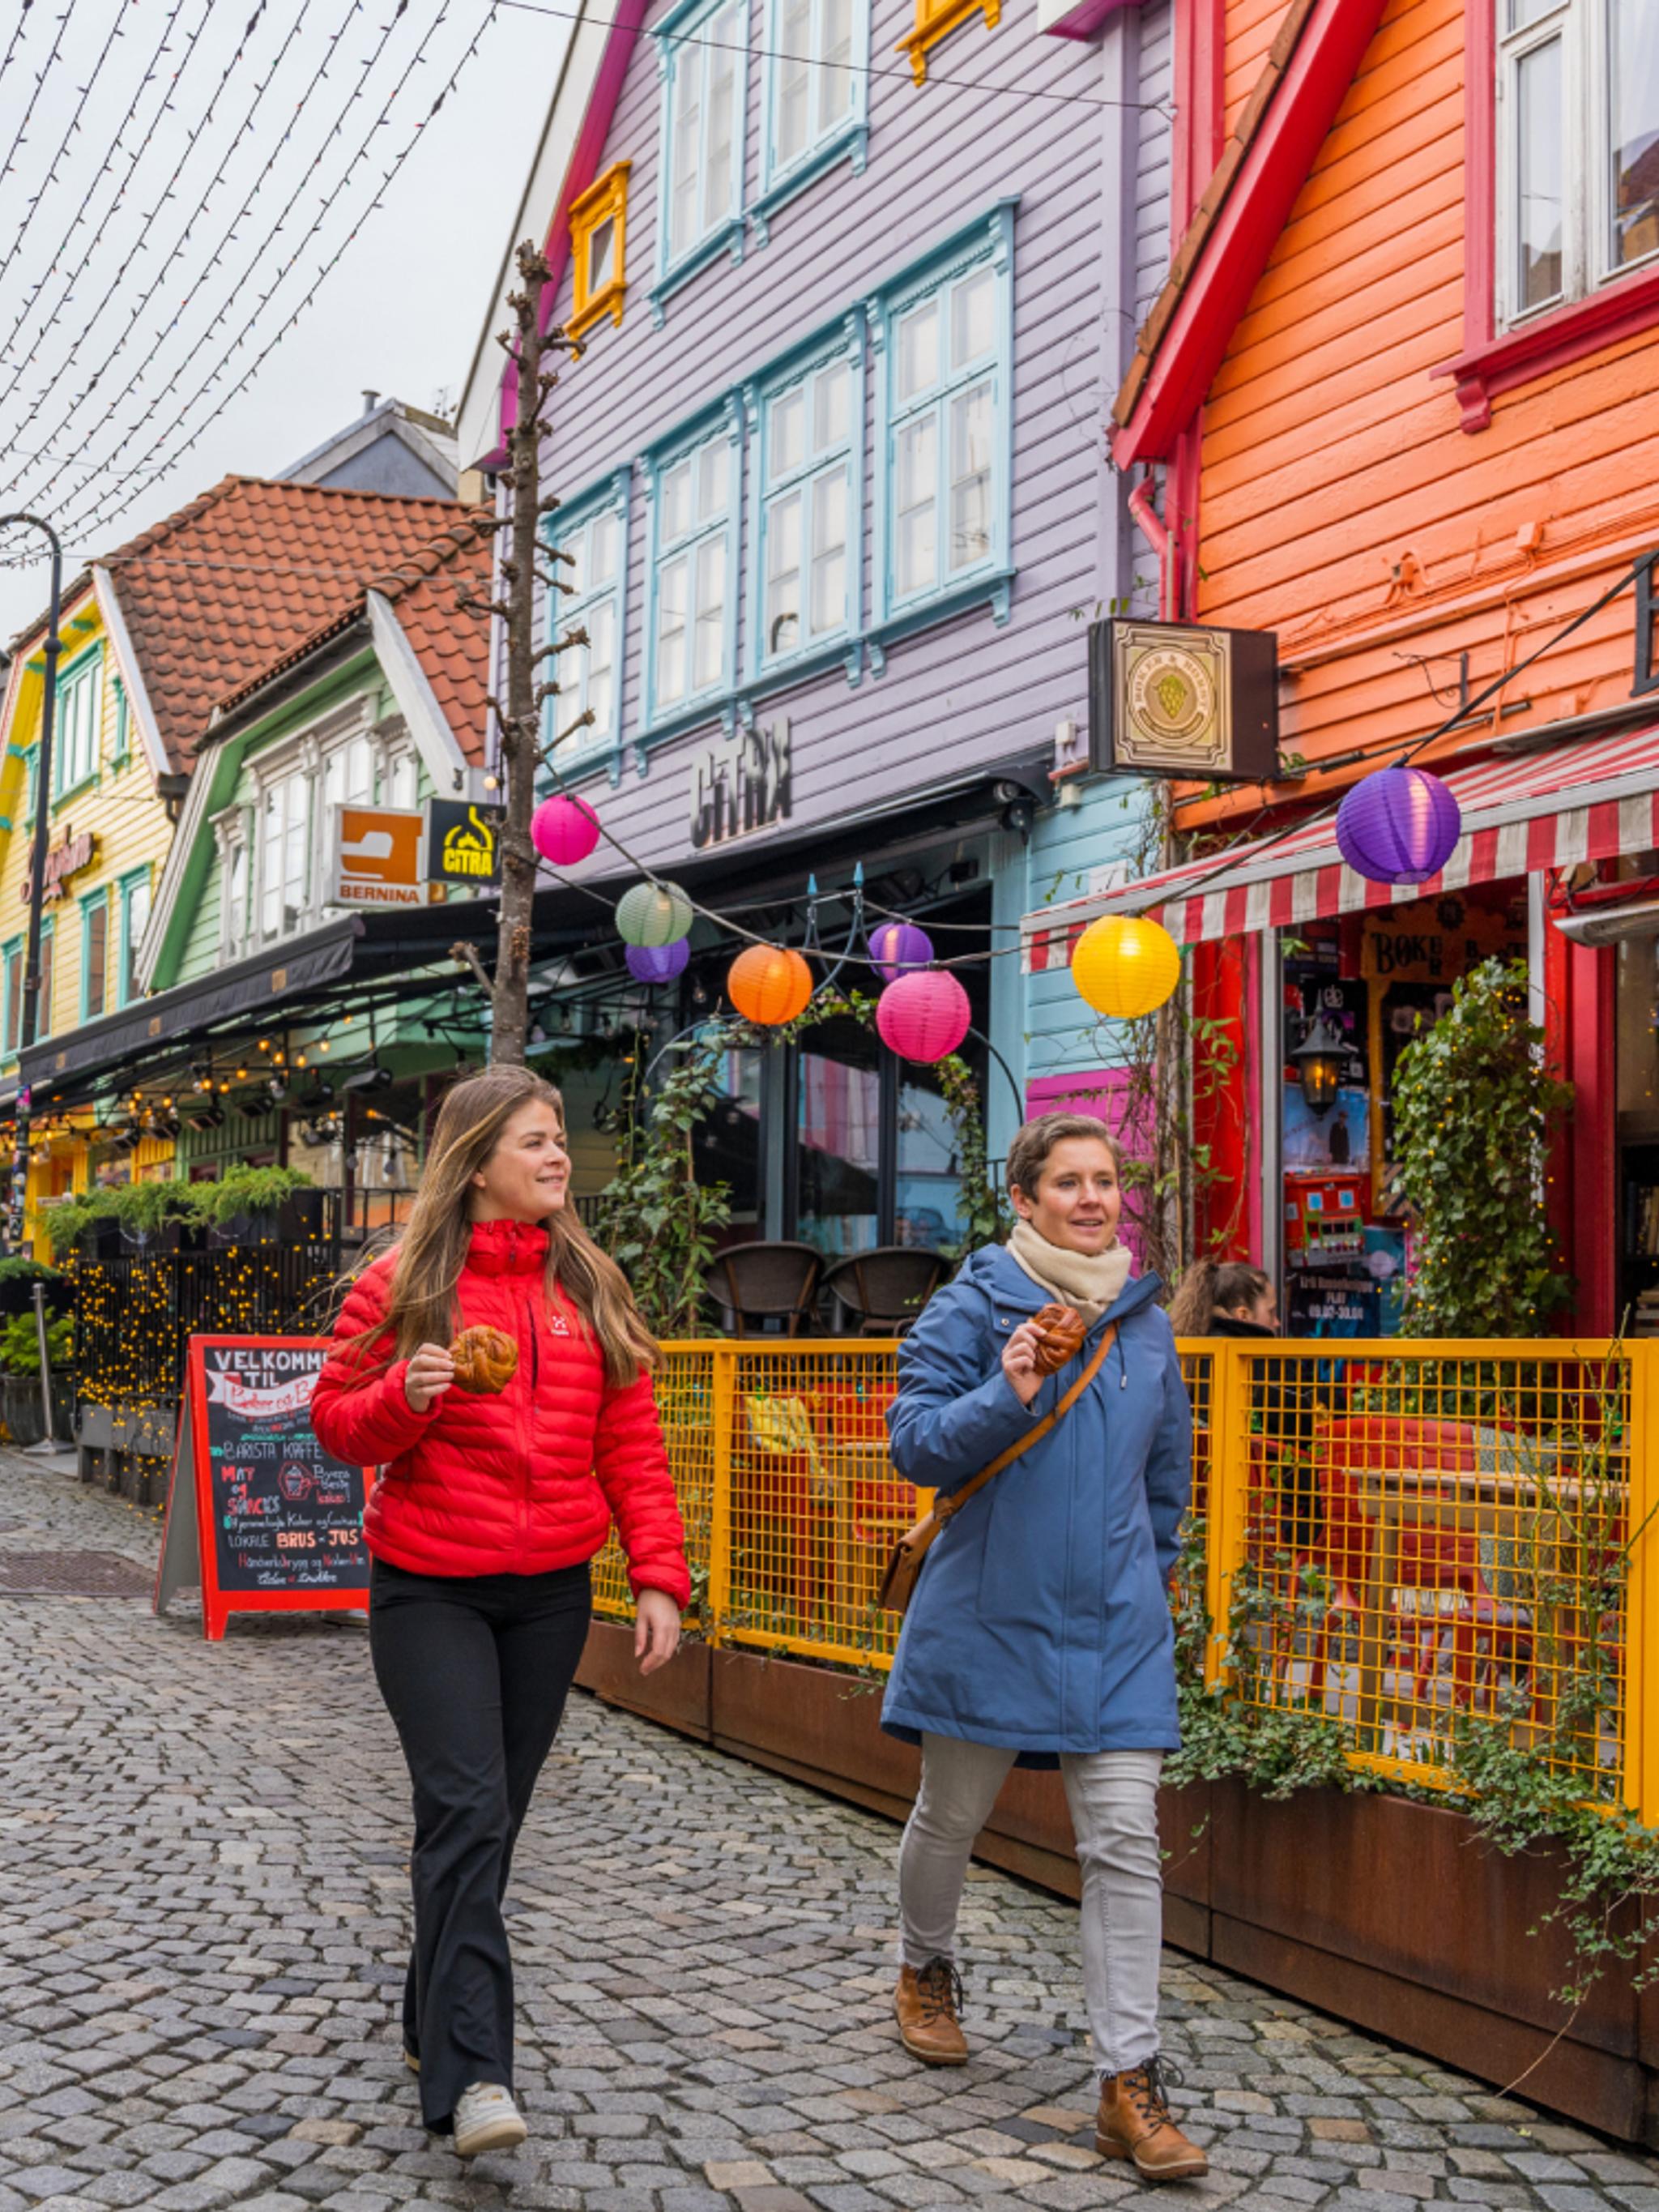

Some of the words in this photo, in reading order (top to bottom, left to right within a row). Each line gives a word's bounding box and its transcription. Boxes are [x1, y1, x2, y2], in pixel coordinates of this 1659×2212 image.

[339, 884, 420, 904] BERNINA
[244, 1371, 279, 1388] TIL
[224, 1441, 275, 1461] BARISTA
[284, 1442, 324, 1459] KAFFE
[221, 1466, 255, 1482] MAT
[228, 1533, 270, 1548] LOKALE
[276, 1531, 317, 1548] BRUS
[328, 1528, 359, 1546] JUS
